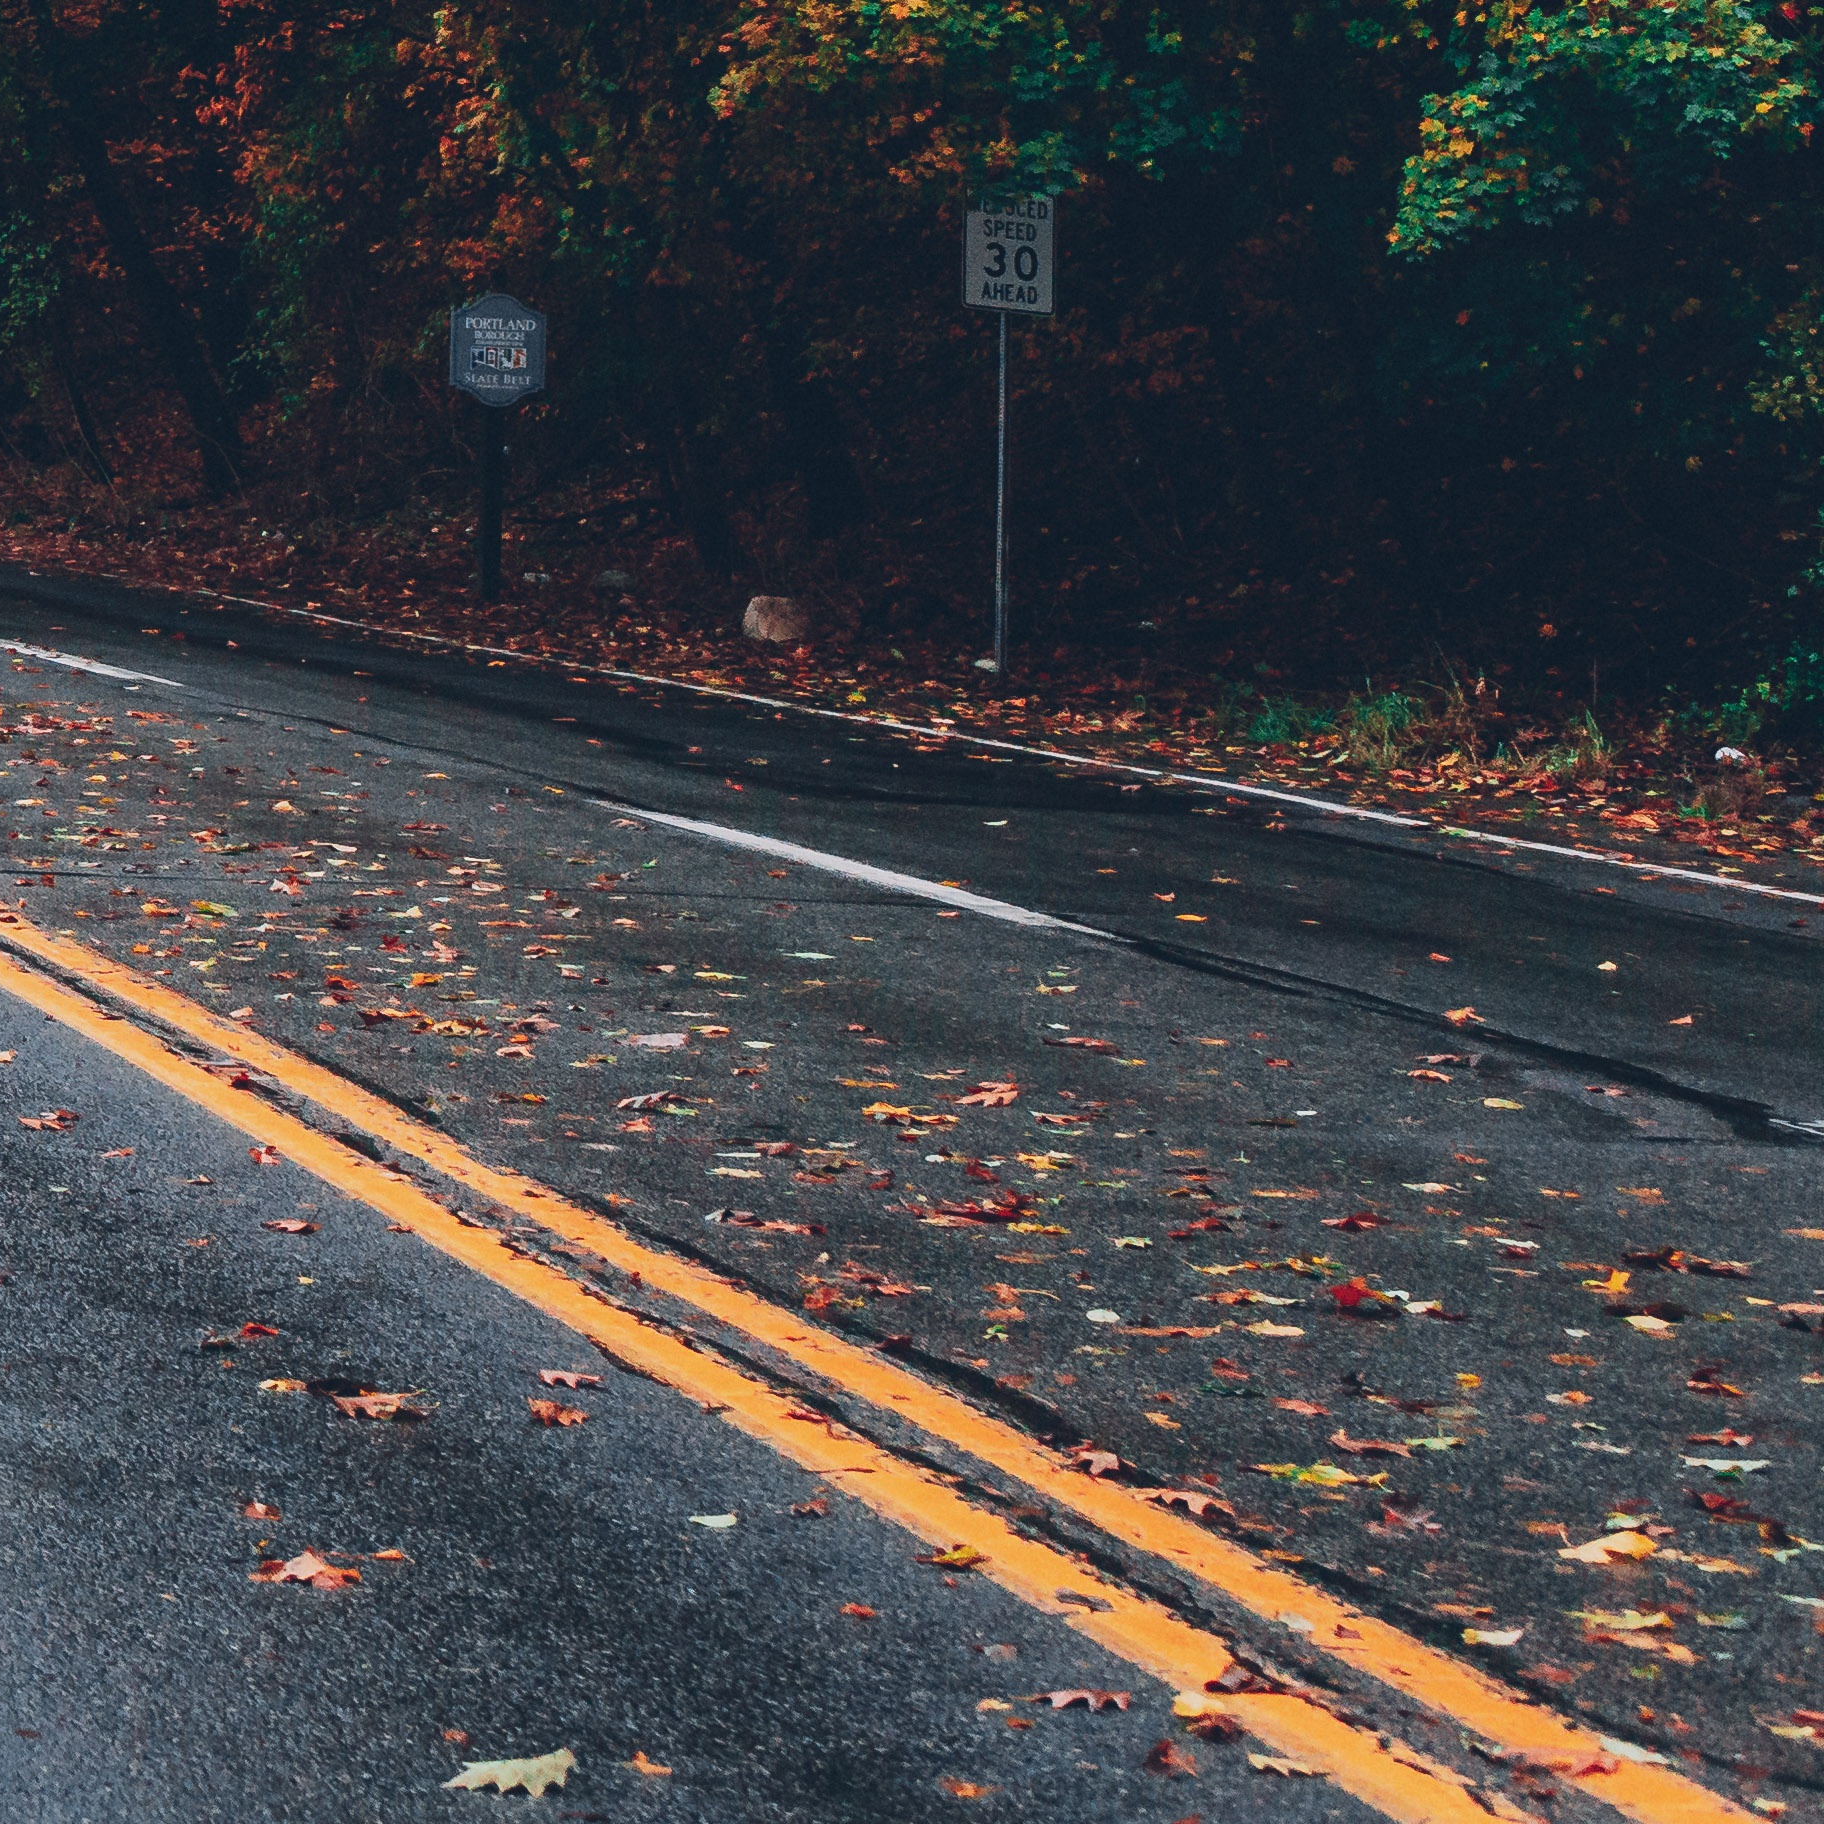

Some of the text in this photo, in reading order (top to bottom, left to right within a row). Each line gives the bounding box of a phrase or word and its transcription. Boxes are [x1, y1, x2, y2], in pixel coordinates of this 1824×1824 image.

[983, 219, 1037, 242] SPEED
[983, 242, 1039, 282] 30
[981, 281, 1038, 304] AHEAD
[465, 317, 536, 331] PORTLAND
